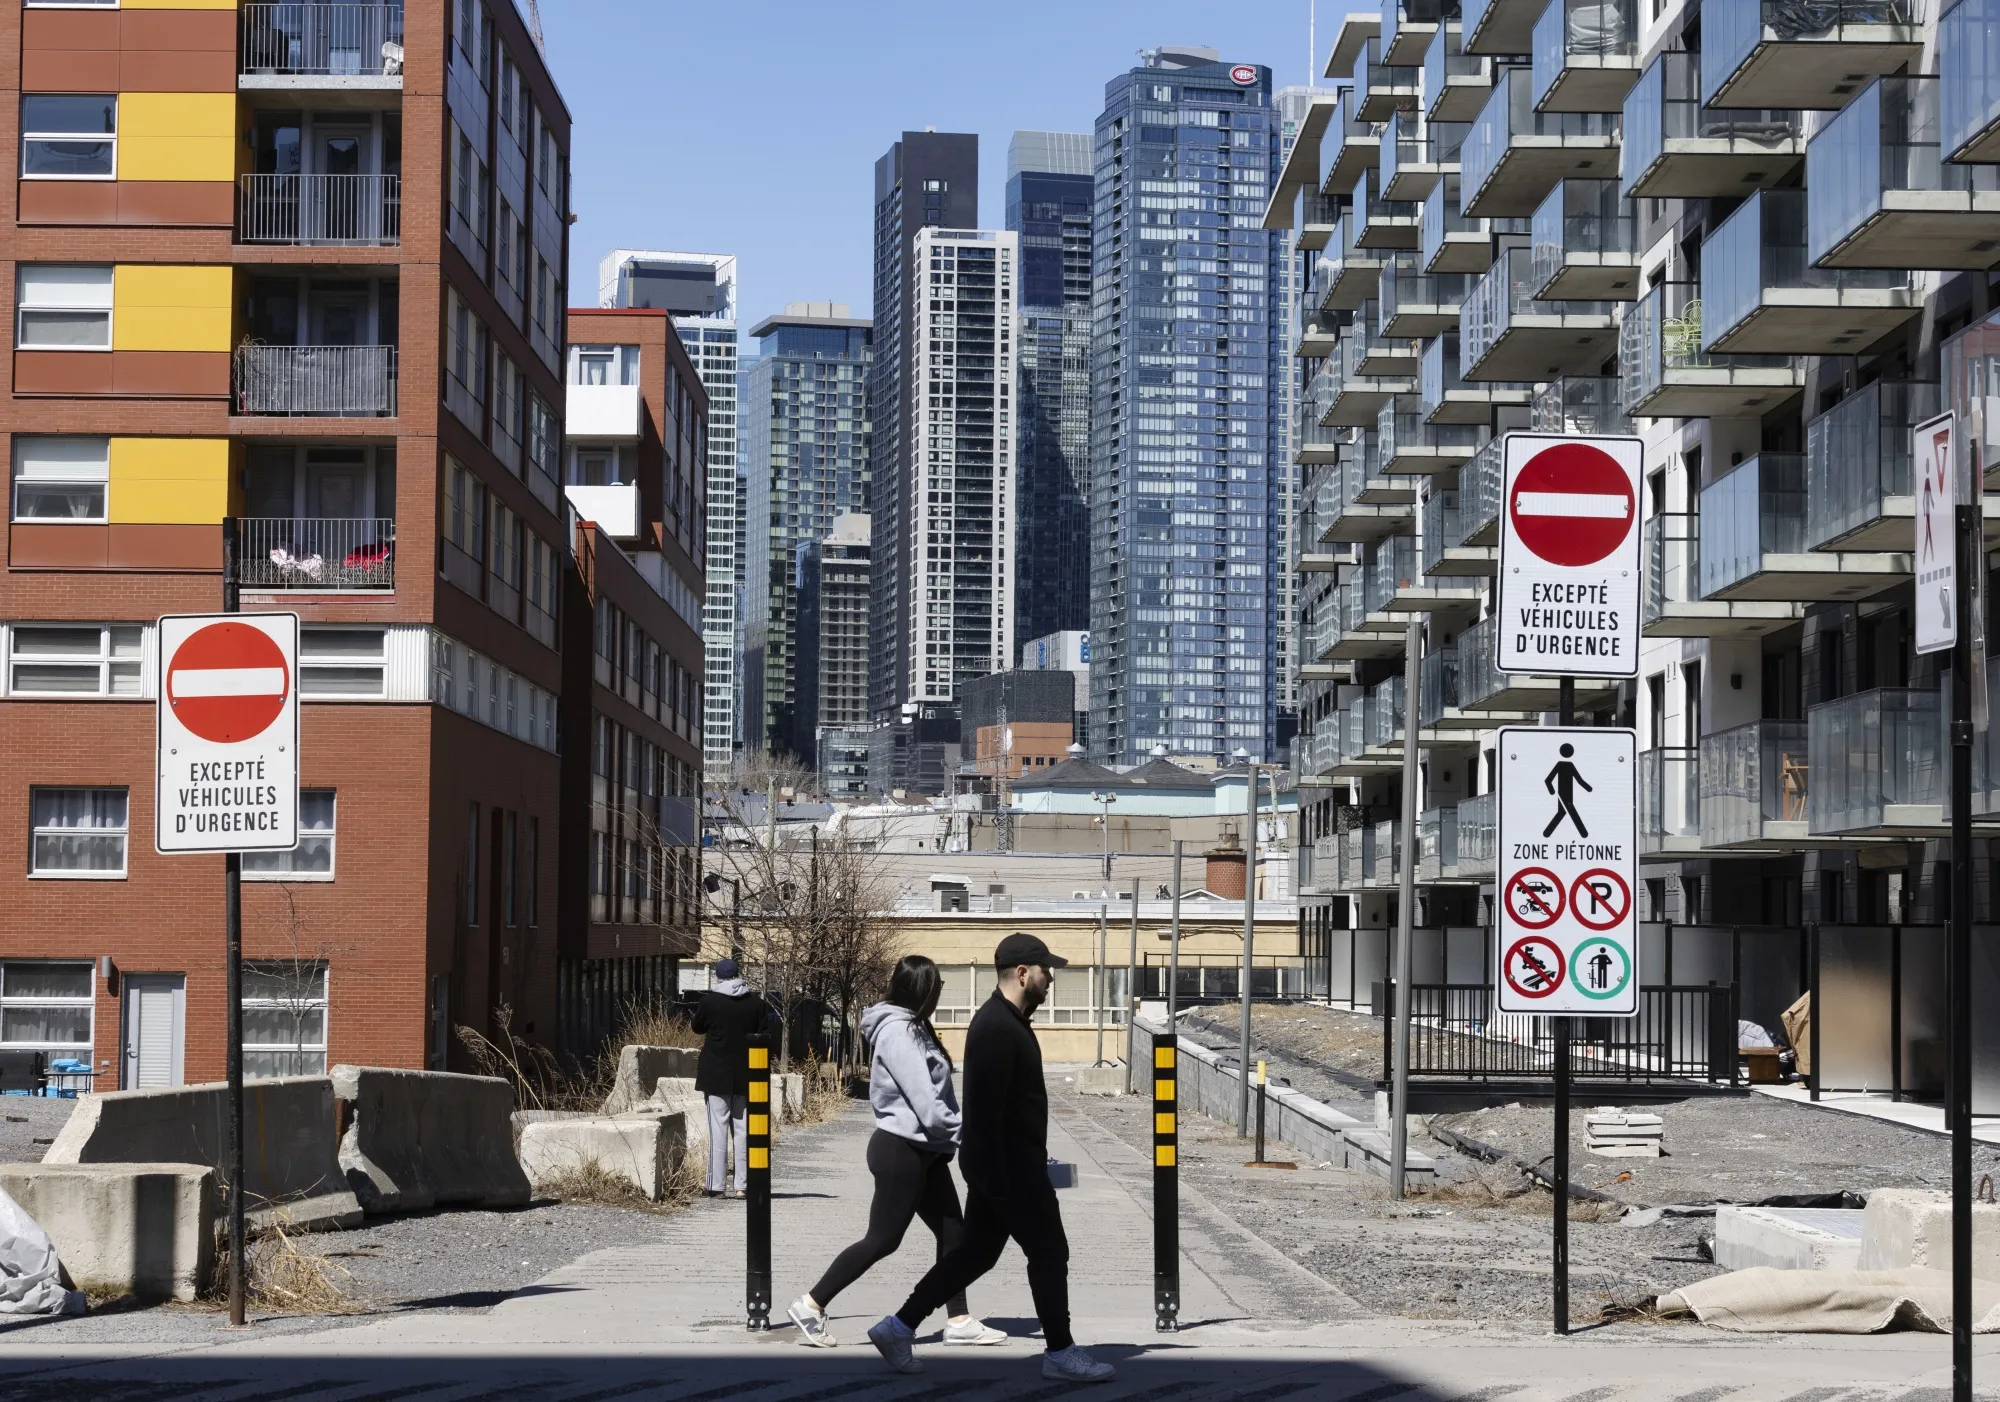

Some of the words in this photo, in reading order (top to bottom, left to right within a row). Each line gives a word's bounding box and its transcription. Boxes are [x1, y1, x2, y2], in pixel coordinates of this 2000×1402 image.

[1532, 579, 1608, 604] EXCEPTÉ
[1520, 603, 1619, 631] VÉHICULES
[1516, 634, 1620, 657] D'URGENCE
[190, 755, 265, 782] EXCEPTÉ
[179, 783, 276, 807] VÉHICULES
[176, 811, 279, 833] D'URGENCE
[1513, 843, 1549, 860] ZONE
[1555, 840, 1622, 861] PIÉTONNE
[1590, 882, 1613, 915] P
